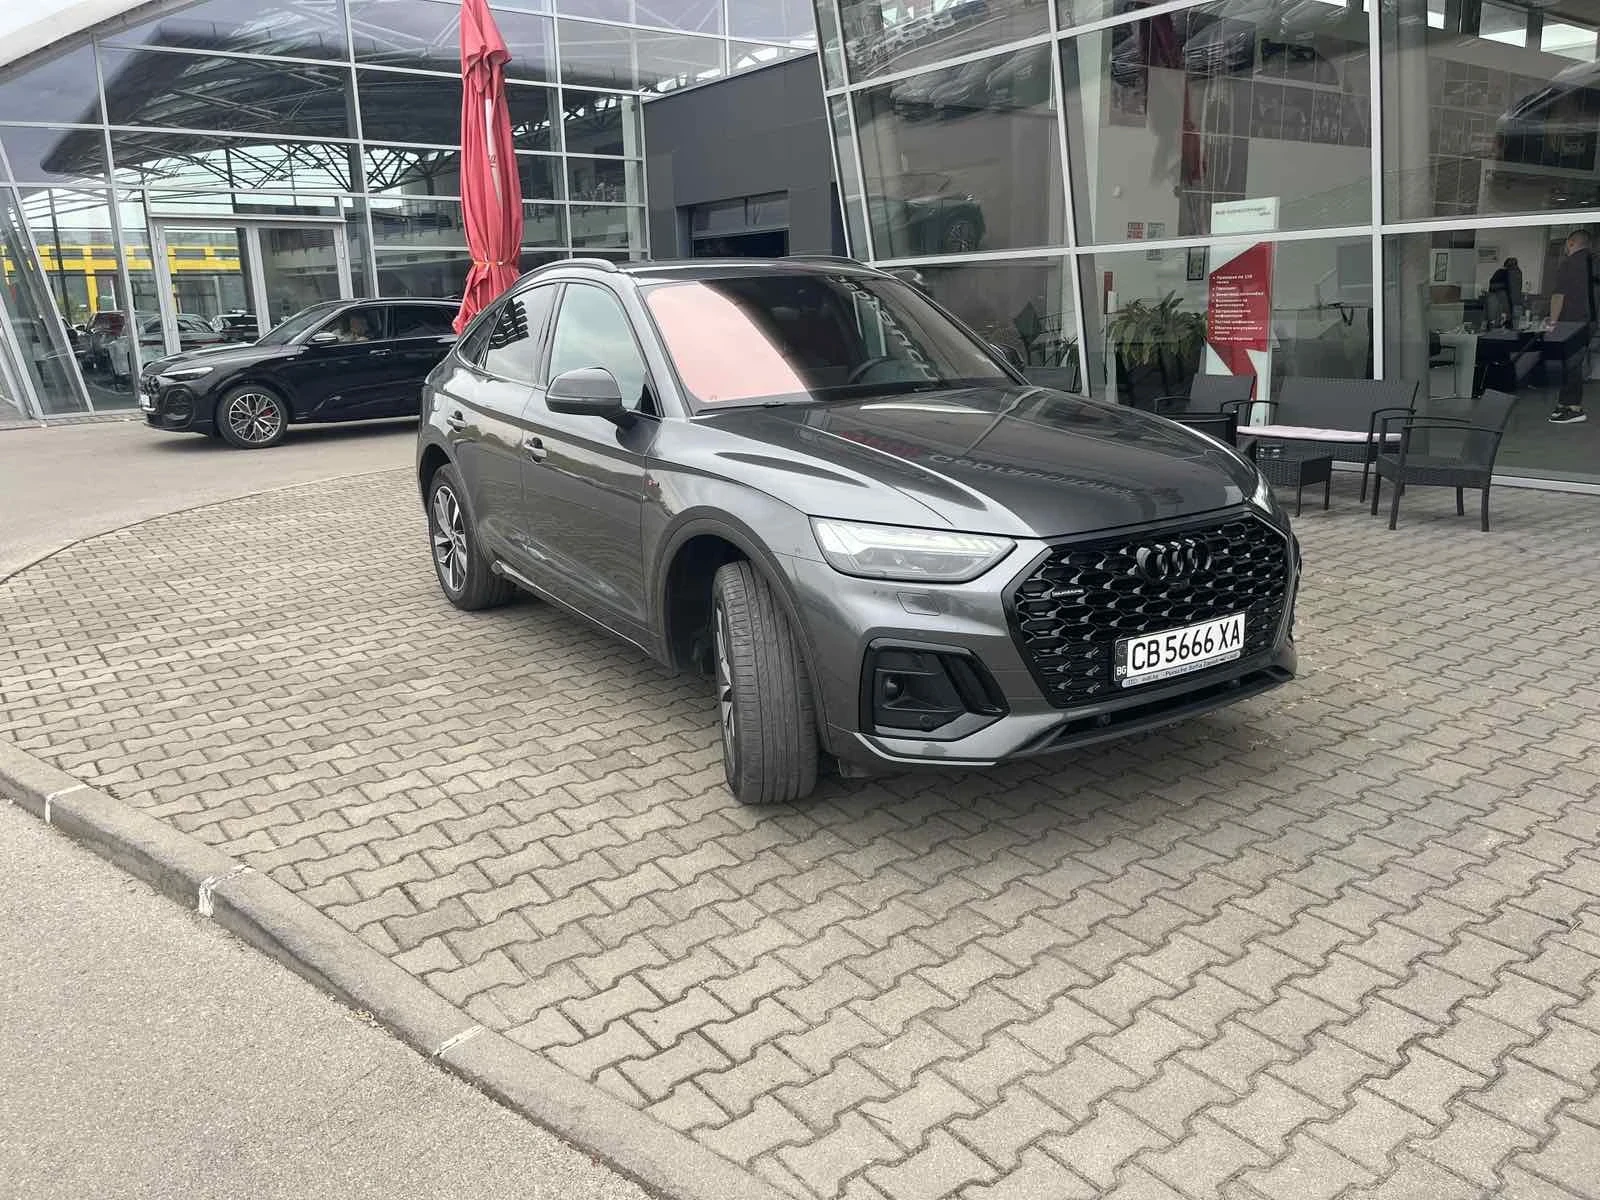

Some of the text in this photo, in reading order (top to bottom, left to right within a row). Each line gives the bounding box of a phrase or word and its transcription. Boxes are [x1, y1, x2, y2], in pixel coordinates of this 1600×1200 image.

[1132, 639, 1160, 670] CB
[1165, 626, 1214, 663] 5666
[1218, 620, 1240, 650] XA
[1116, 665, 1127, 676] BG
